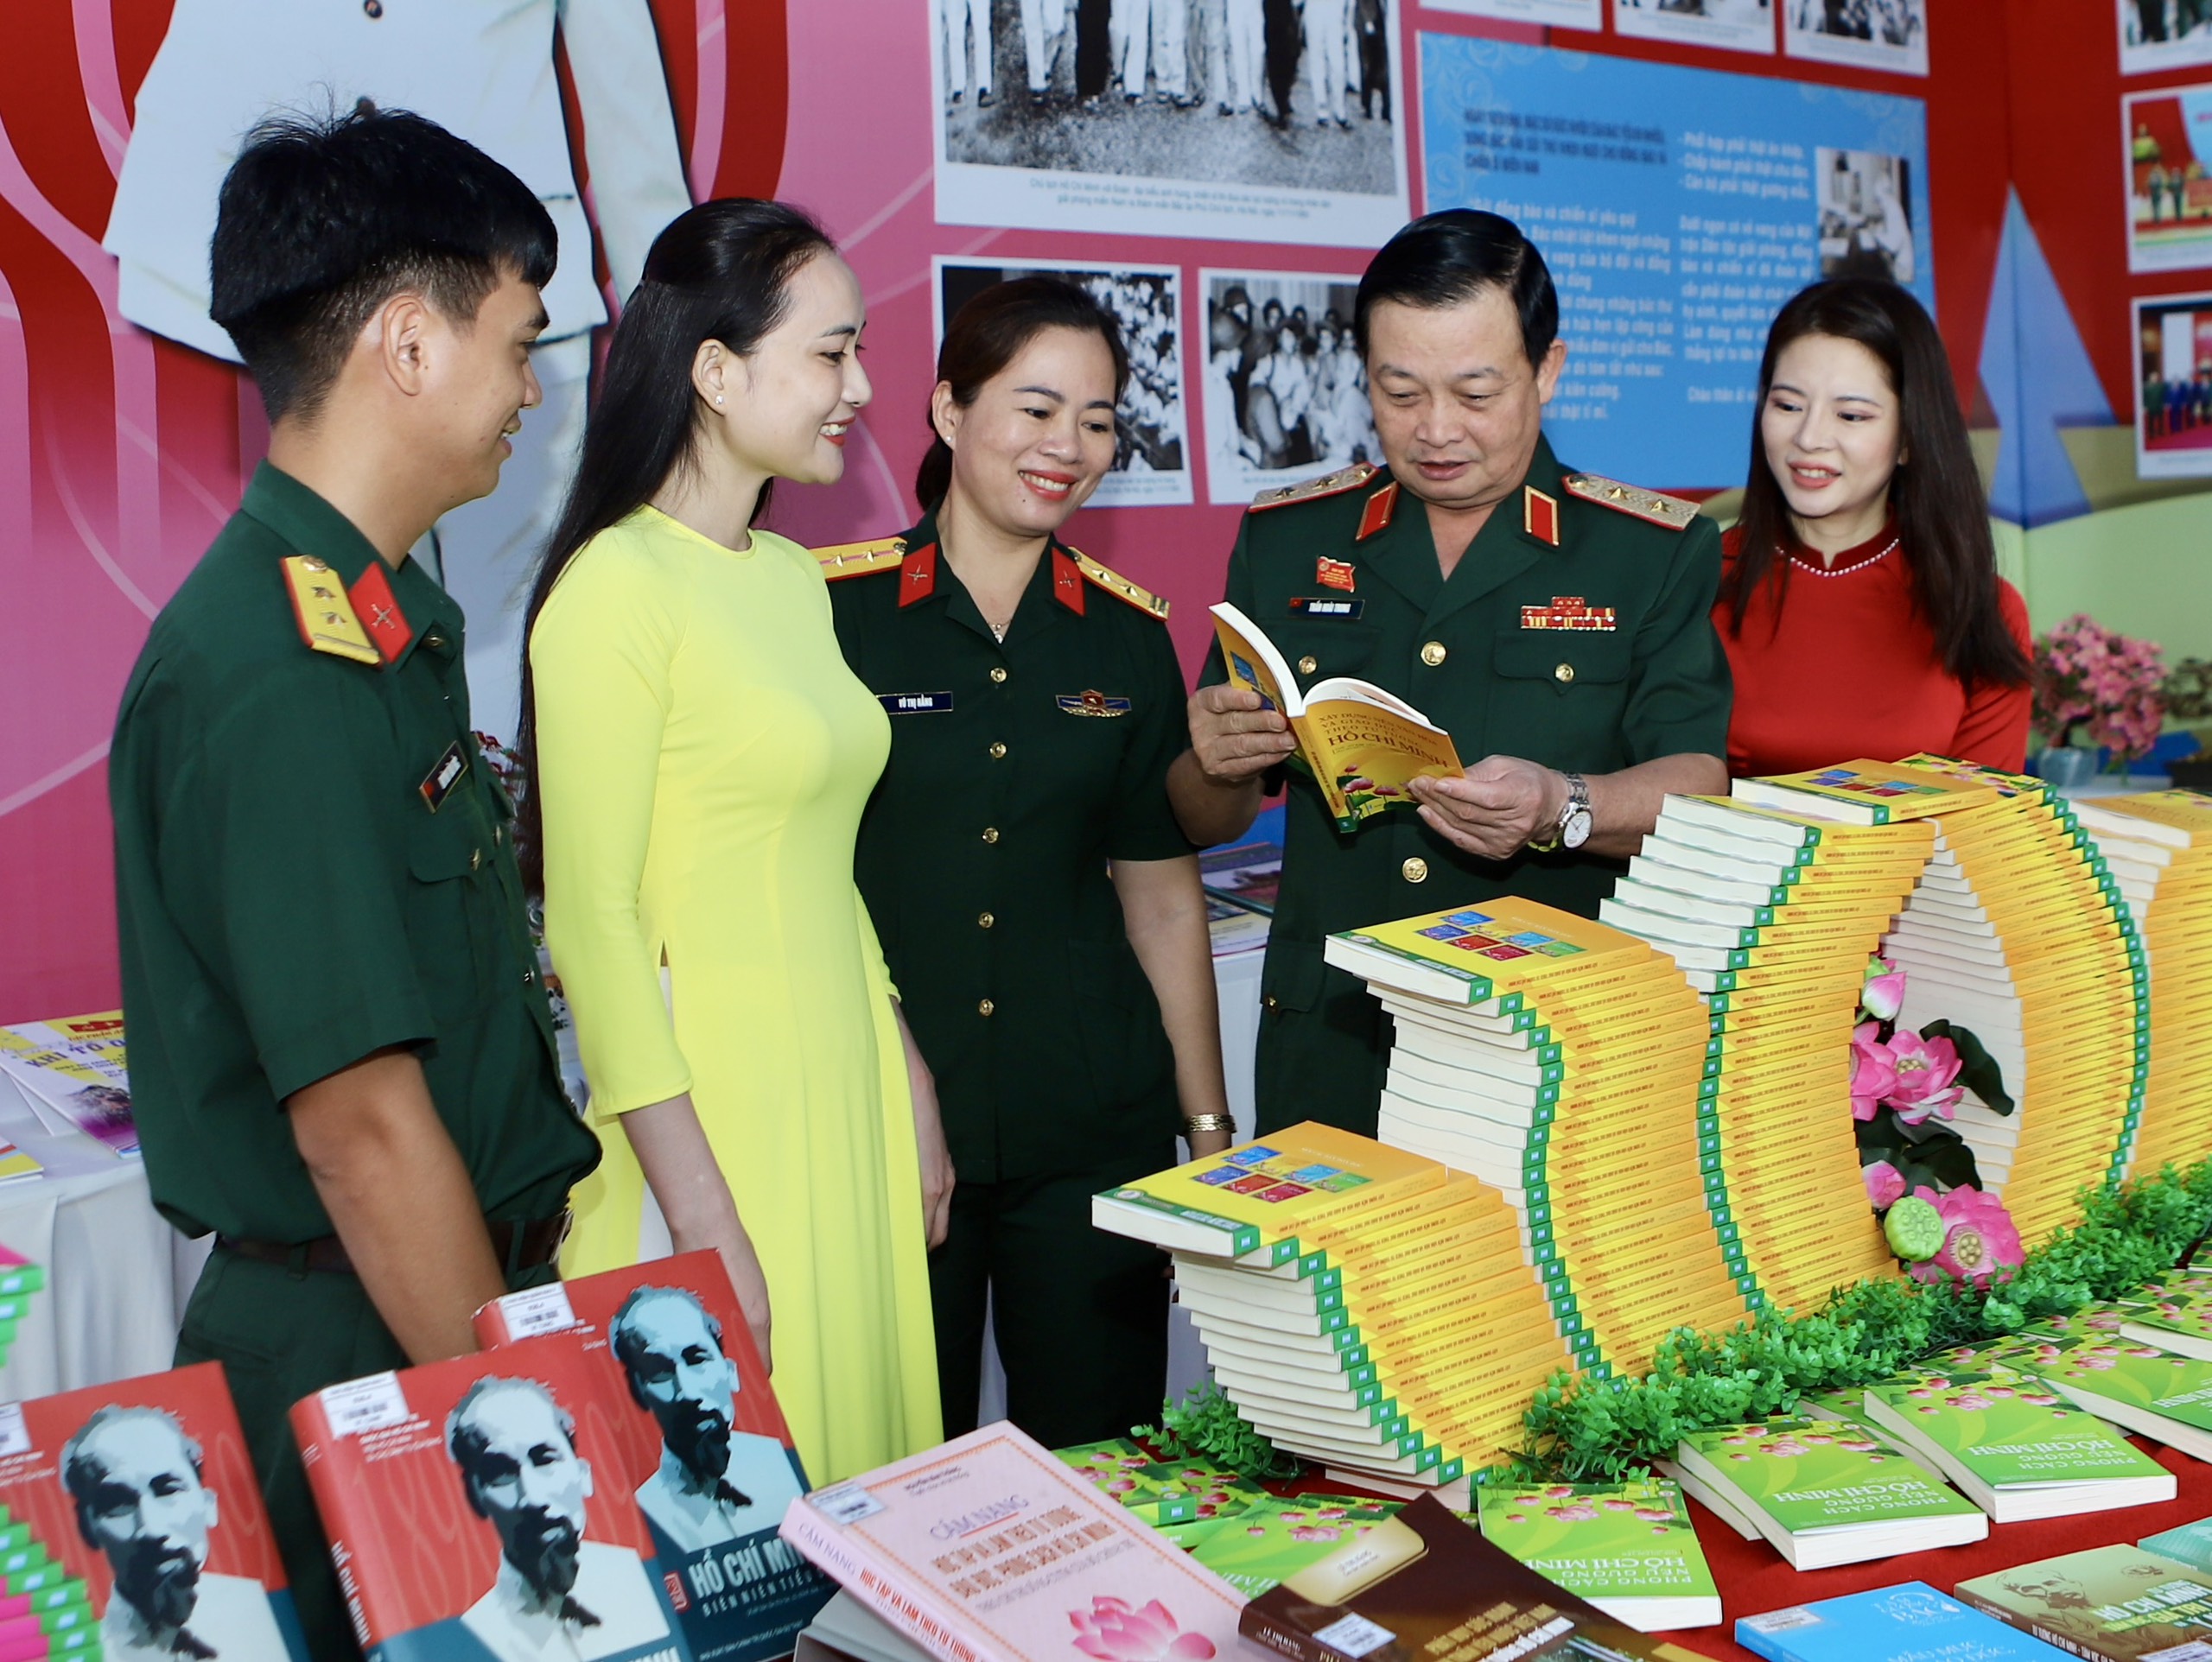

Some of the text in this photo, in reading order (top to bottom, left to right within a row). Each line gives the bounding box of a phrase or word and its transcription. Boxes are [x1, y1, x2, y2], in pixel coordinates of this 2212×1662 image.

[1398, 741, 1449, 769] MINH
[24, 1050, 68, 1069] KHI
[1967, 1443, 2035, 1456] MINH
[2073, 1456, 2138, 1468] PHONG
[1772, 1488, 1844, 1503] MINH
[1880, 1496, 1948, 1510] PHONG
[722, 1538, 767, 1588] CHÍ
[1617, 1576, 1693, 1587] PHONG
